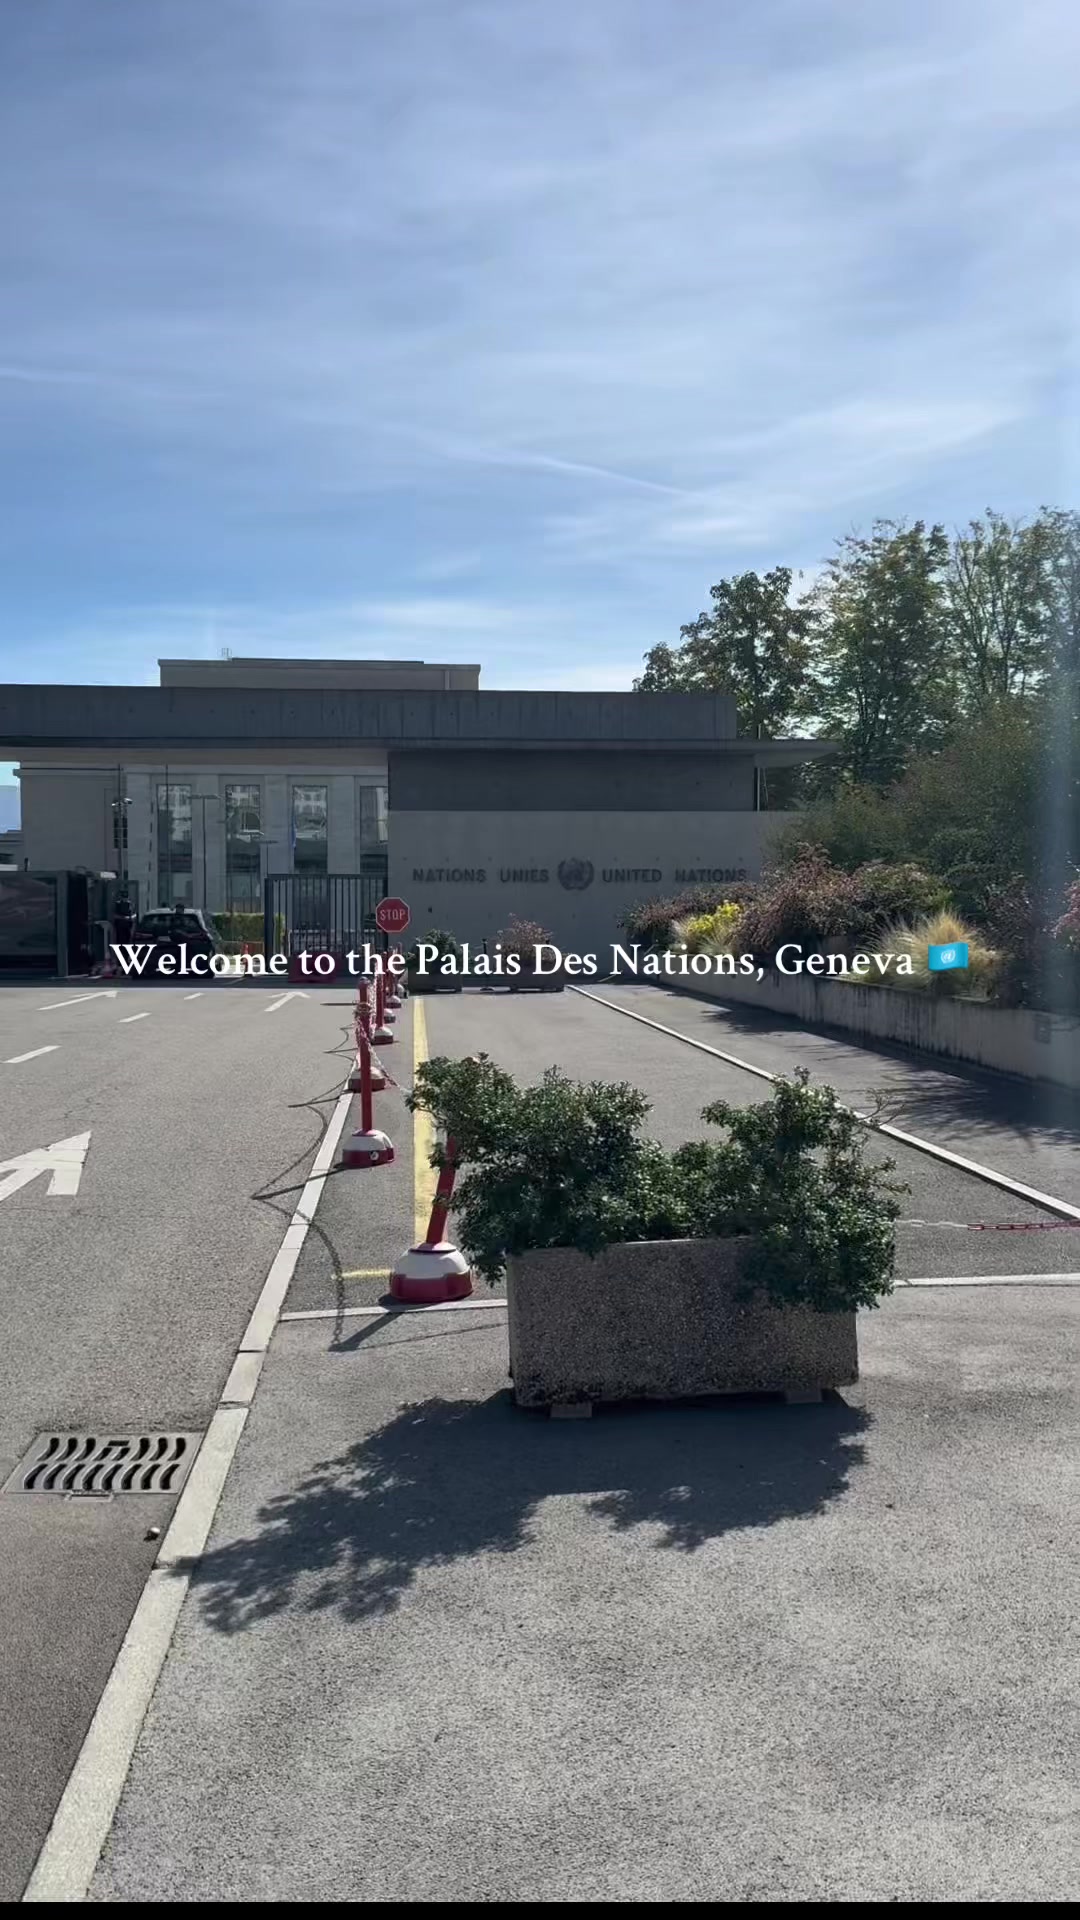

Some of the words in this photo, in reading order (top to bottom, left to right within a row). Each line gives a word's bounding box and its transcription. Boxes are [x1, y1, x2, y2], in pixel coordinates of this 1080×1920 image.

[412, 867, 487, 884] NATIONS
[500, 867, 549, 884] UNIES
[602, 867, 663, 884] UNITED
[674, 867, 748, 884] NATIONS
[380, 909, 406, 921] STOP
